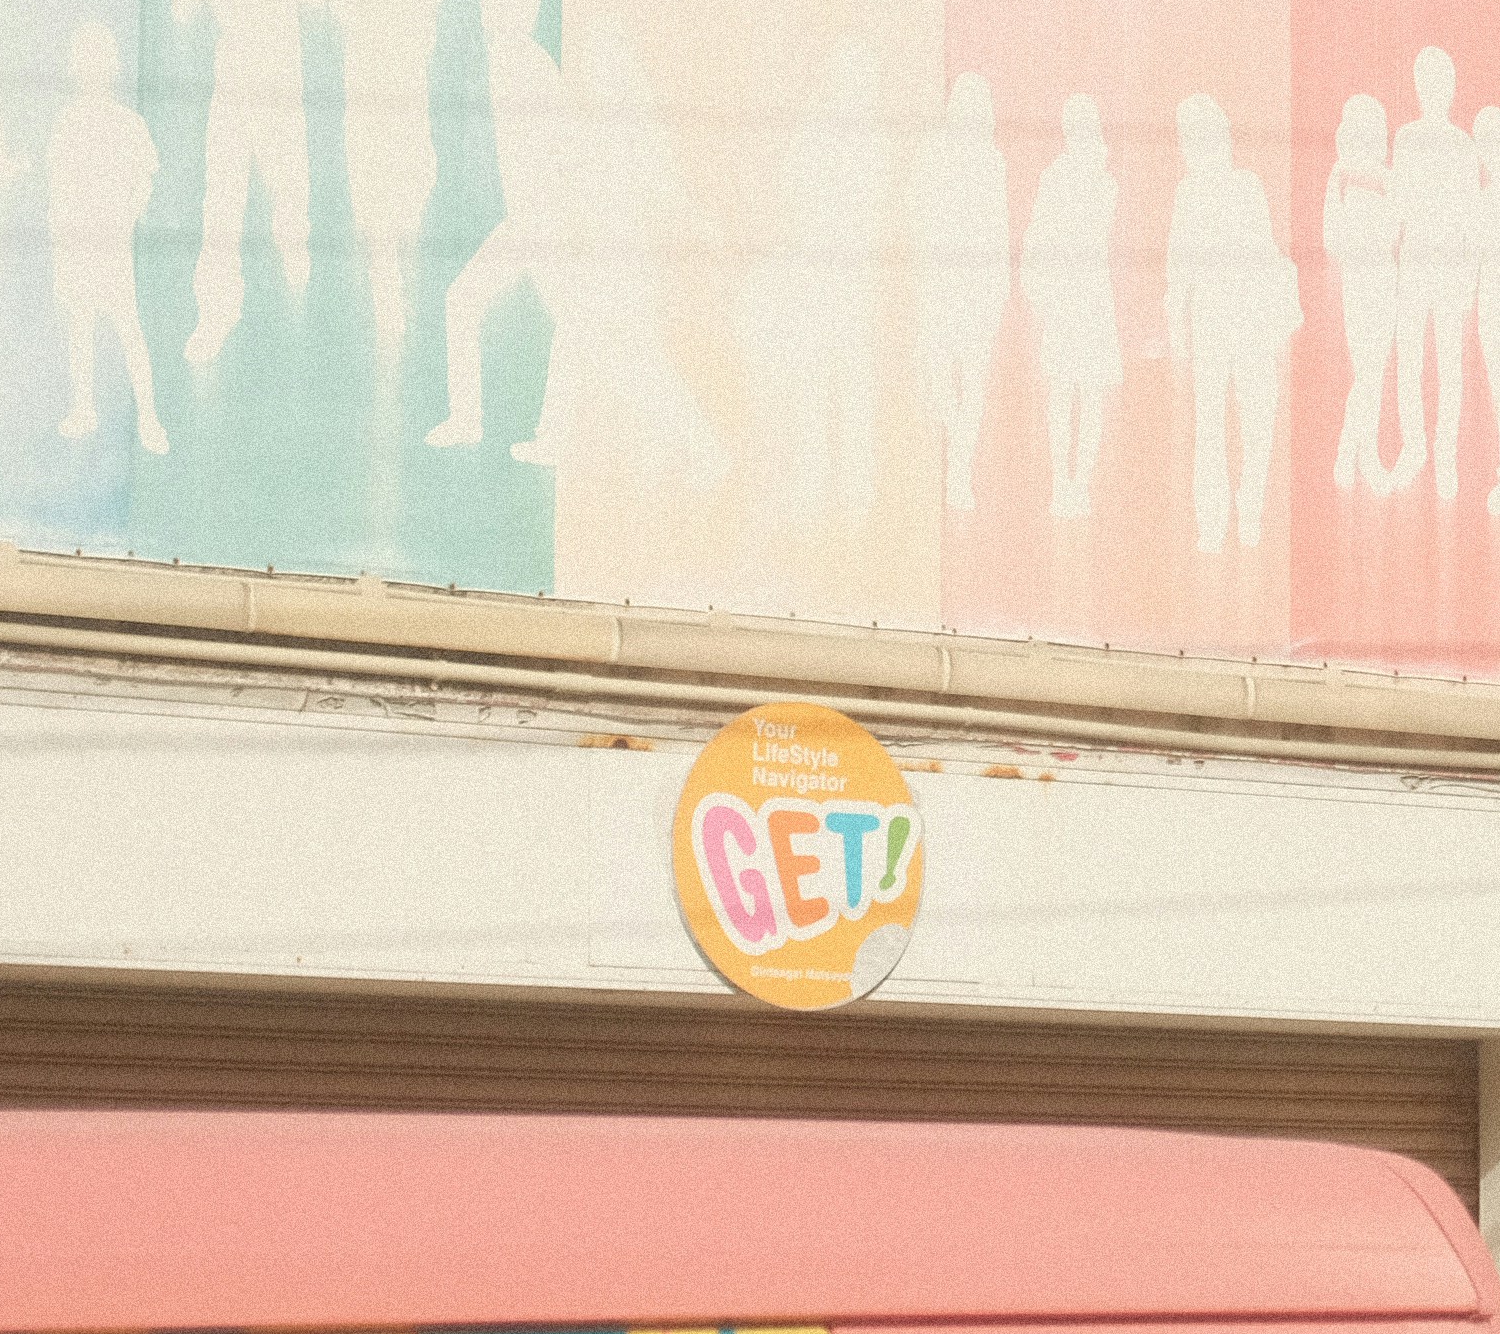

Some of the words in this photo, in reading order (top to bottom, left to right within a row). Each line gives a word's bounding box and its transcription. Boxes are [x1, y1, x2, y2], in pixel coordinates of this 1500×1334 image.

[752, 717, 798, 741] Your
[752, 742, 840, 772] LifeStyle
[752, 767, 848, 794] Navigator
[700, 804, 912, 944] GET!
